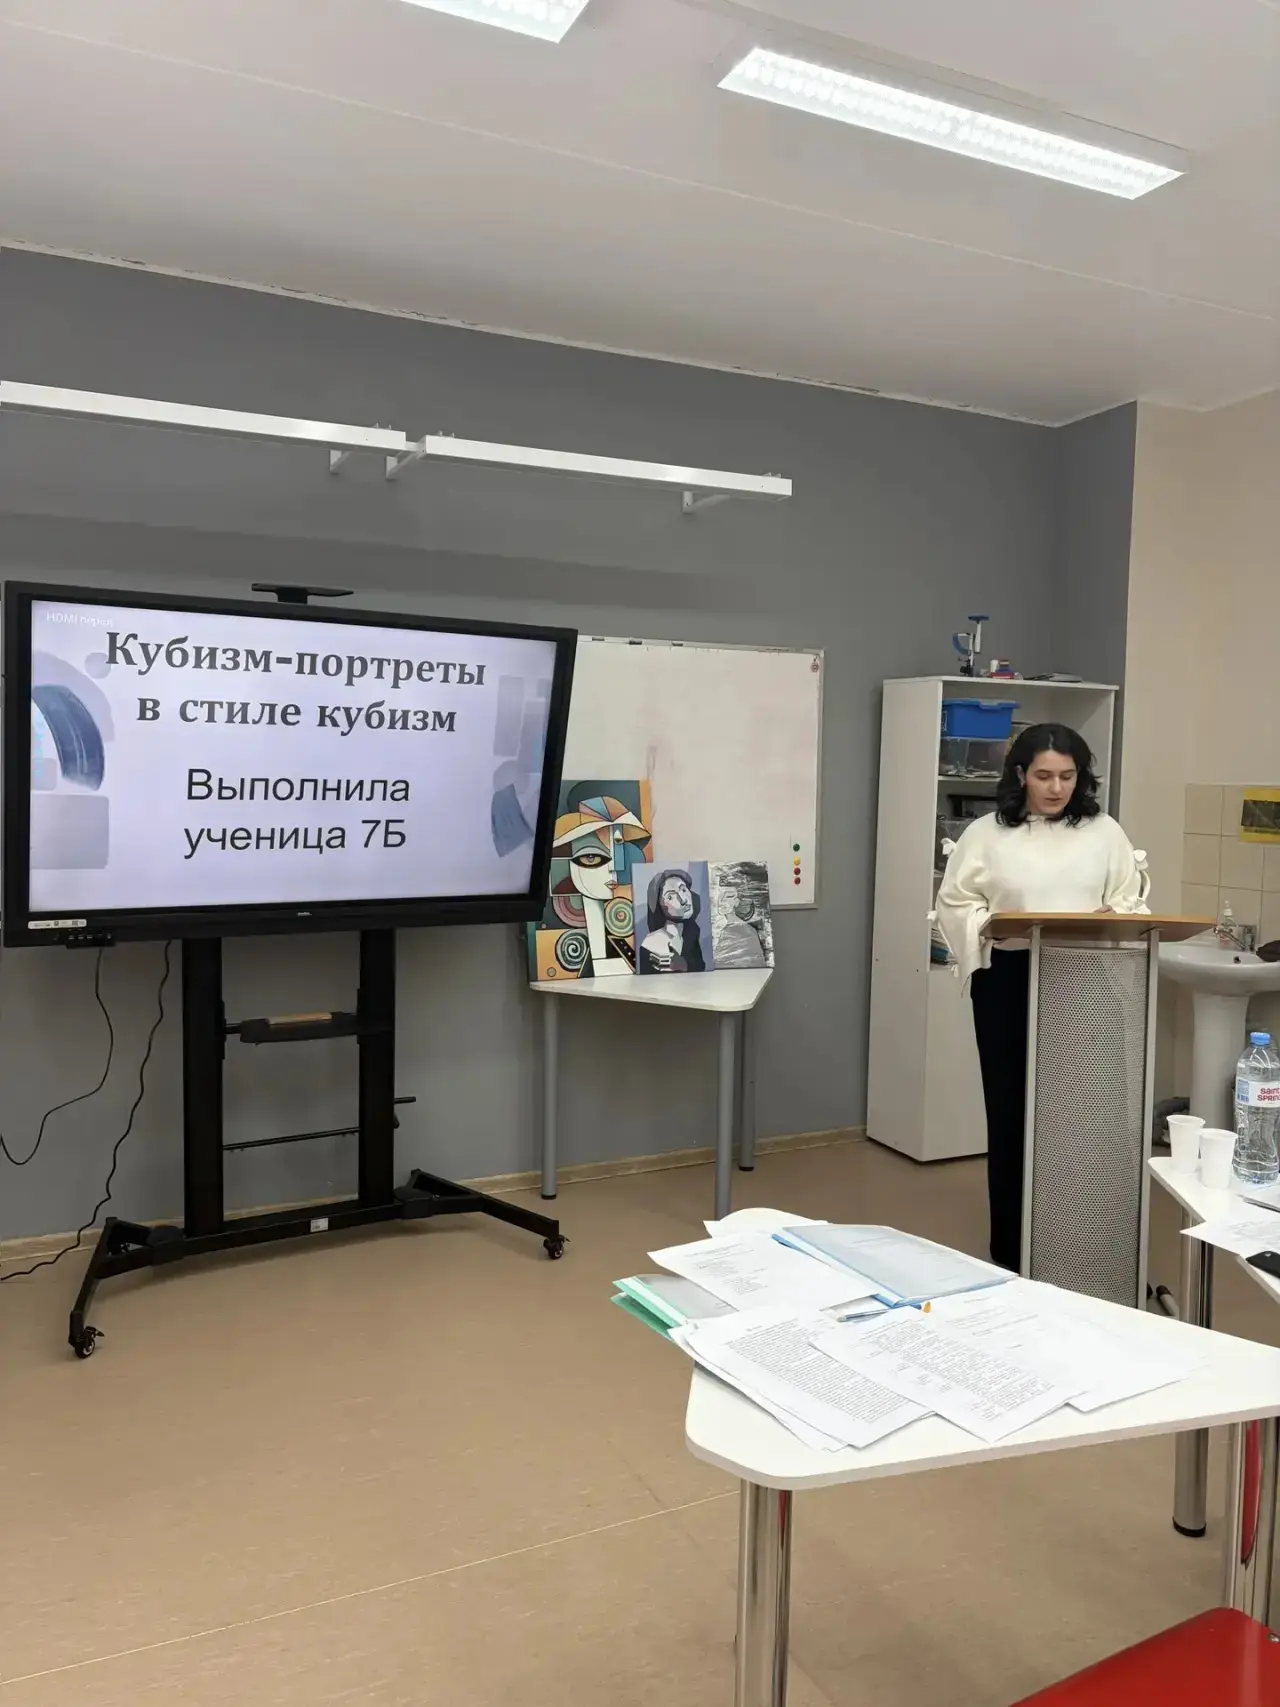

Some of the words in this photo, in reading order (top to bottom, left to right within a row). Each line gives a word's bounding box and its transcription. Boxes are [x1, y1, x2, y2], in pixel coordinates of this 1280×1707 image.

[46, 611, 78, 625] HDMI
[106, 631, 486, 689] Кубизм-портреты
[136, 697, 160, 721] в
[180, 700, 301, 726] стиле
[317, 700, 456, 736] кубизм
[187, 769, 409, 801] Выполнила
[184, 827, 345, 859] ученица
[362, 819, 406, 848] 7Б
